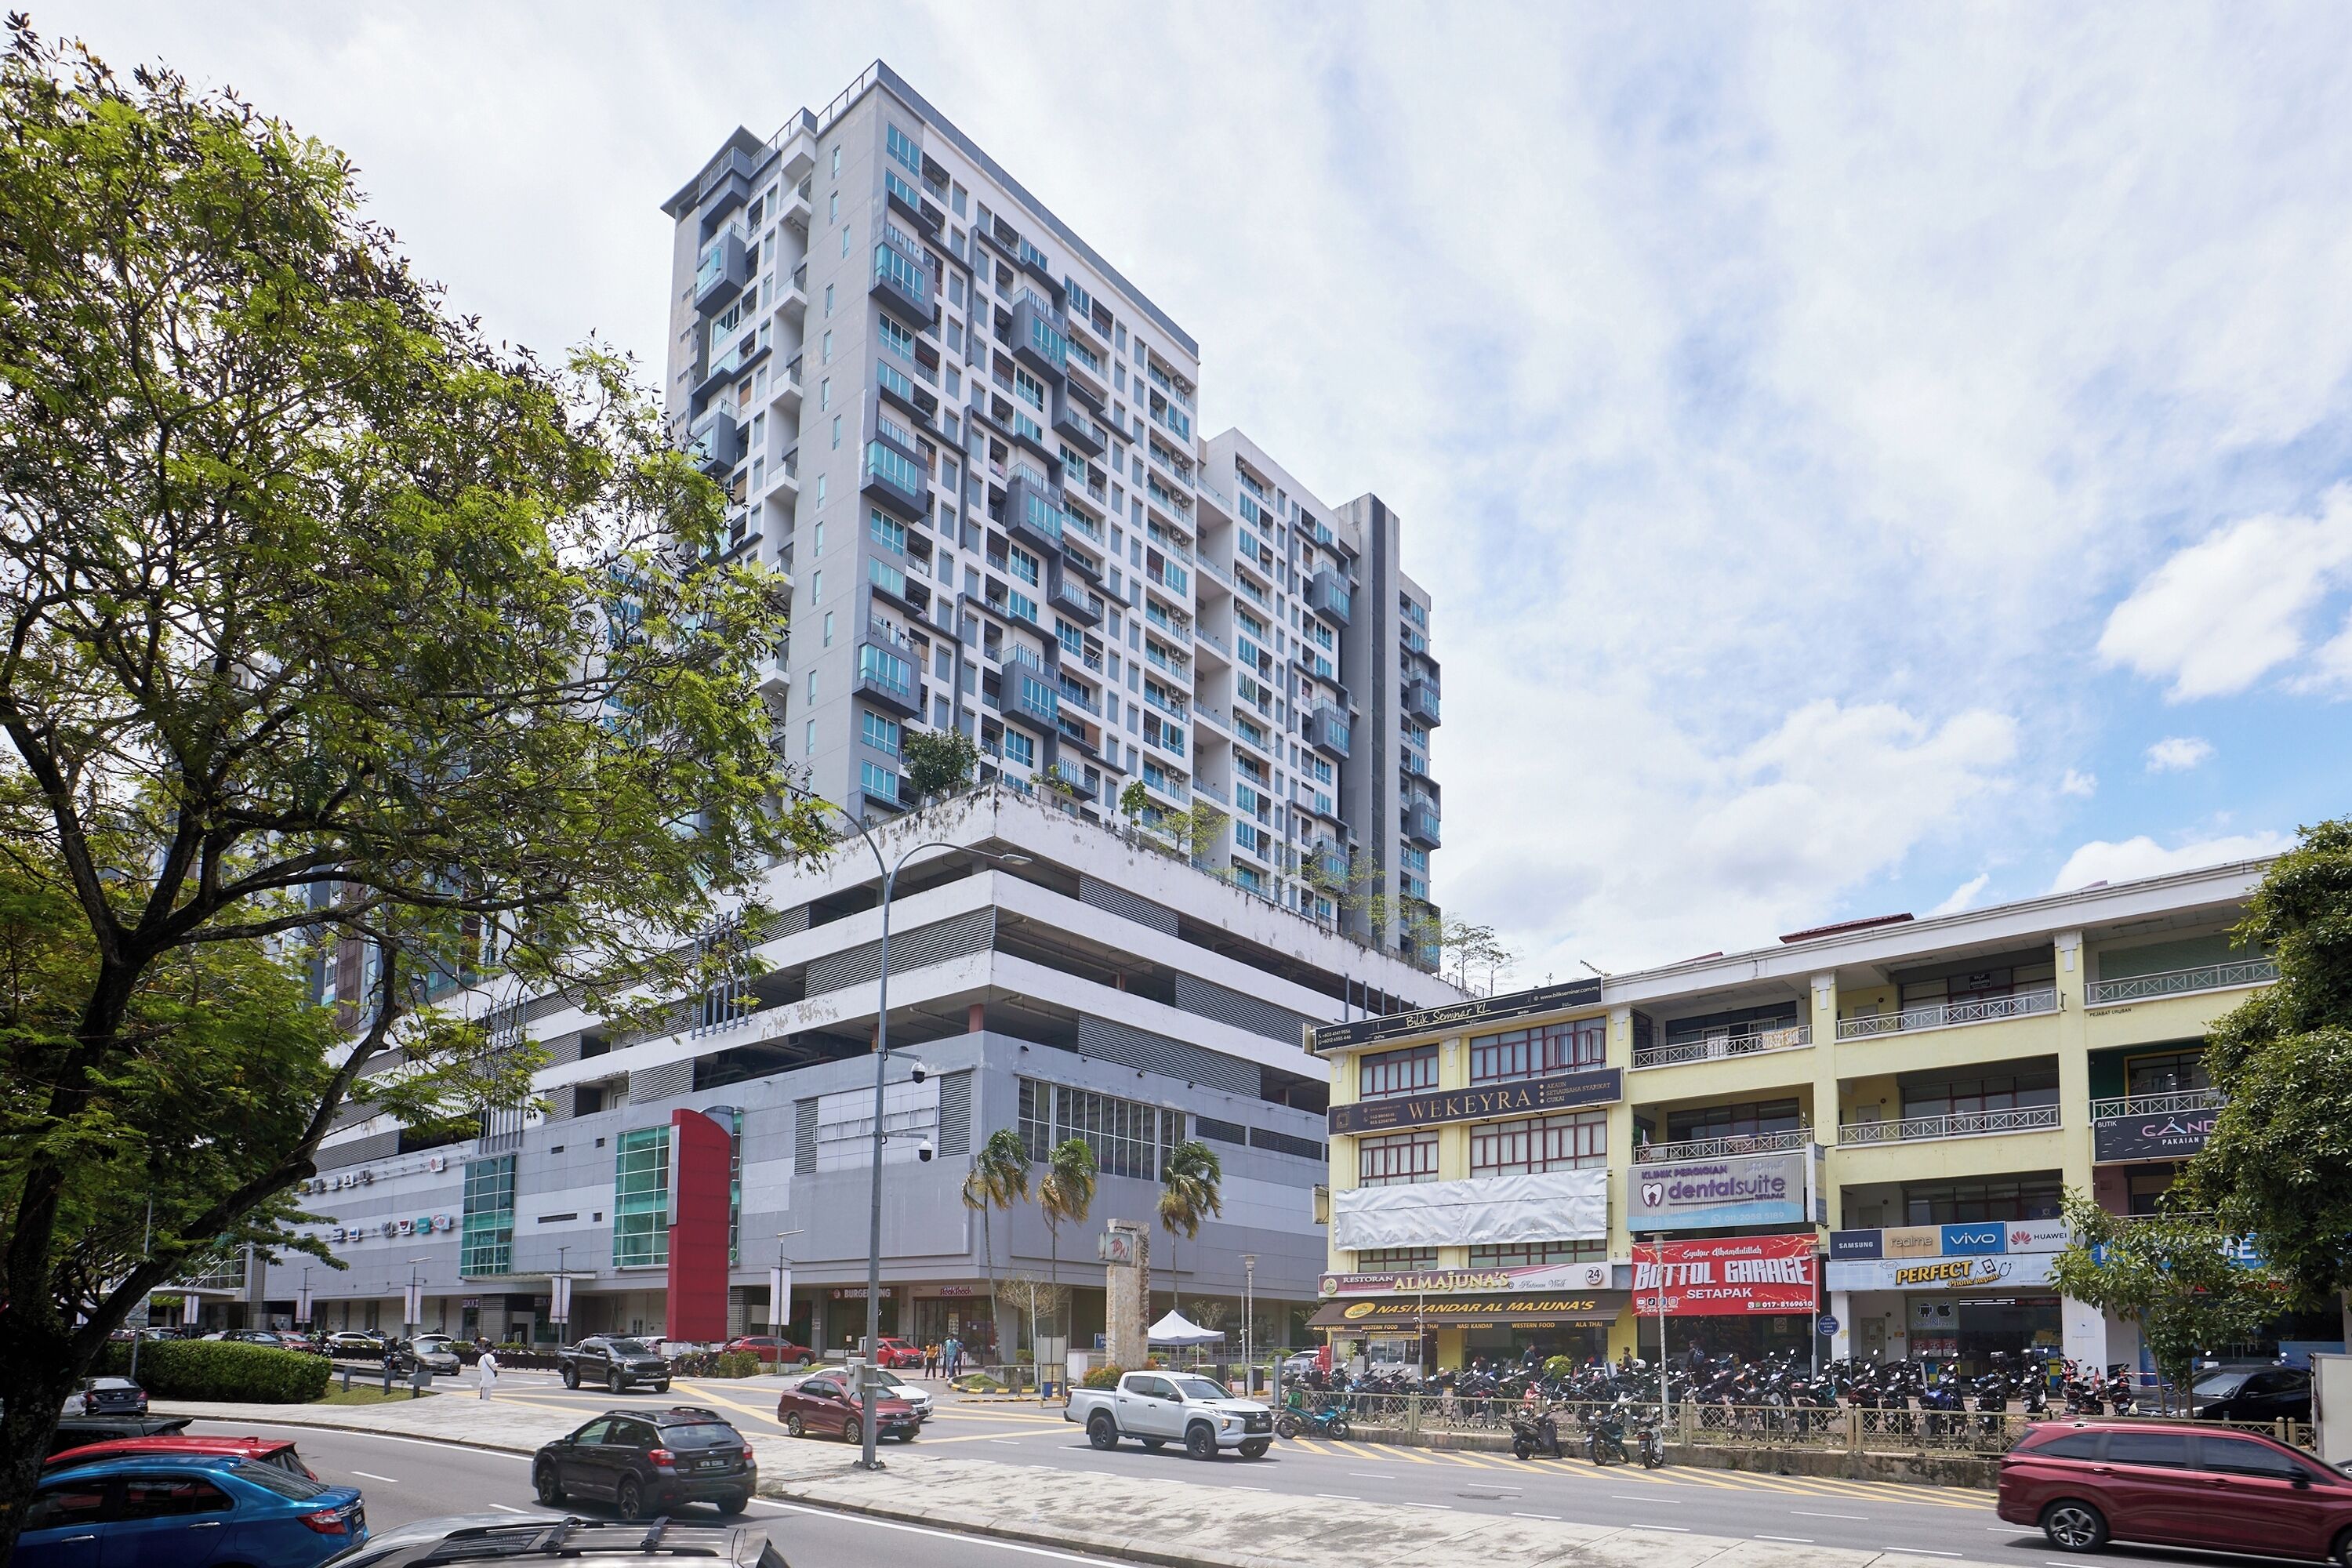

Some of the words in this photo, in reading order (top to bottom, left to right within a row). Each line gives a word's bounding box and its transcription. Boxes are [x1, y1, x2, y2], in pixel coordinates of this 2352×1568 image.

[1540, 985, 1599, 1000] www.bilikseminar.com.my
[1406, 1014, 1428, 1027] Bilik
[1432, 1009, 1472, 1022] Seminar
[1476, 1003, 1491, 1014] KL
[1547, 1087, 1581, 1096] SETIAUSAHA
[1582, 1083, 1610, 1091] SYARIKAT
[1407, 1088, 1532, 1120] WEKEYRA
[1642, 1169, 1672, 1179] KLINIK
[1674, 1165, 1727, 1177] PERGIGIAN
[1668, 1174, 1786, 1200] dentalsuite
[1890, 1236, 1933, 1248] realme
[1951, 1232, 1996, 1245] vivo
[1682, 1249, 1710, 1259] Syukur
[1711, 1245, 1762, 1256] Alhamdulillah
[1588, 1269, 1599, 1279] 24
[1633, 1261, 1717, 1291] BOTTOL
[1725, 1256, 1813, 1285] GARAGE
[1896, 1258, 1973, 1285] PERFECT
[1949, 1278, 1973, 1287] Phone
[1974, 1274, 1998, 1285] Repair
[844, 1289, 868, 1298] BURGE
[1686, 1287, 1753, 1299] SETAPAK
[1376, 1305, 1414, 1314] NASI
[1413, 1303, 1483, 1313] KANDAR
[1482, 1303, 1503, 1312] AL
[1505, 1300, 1595, 1312] MAJUNA'S
